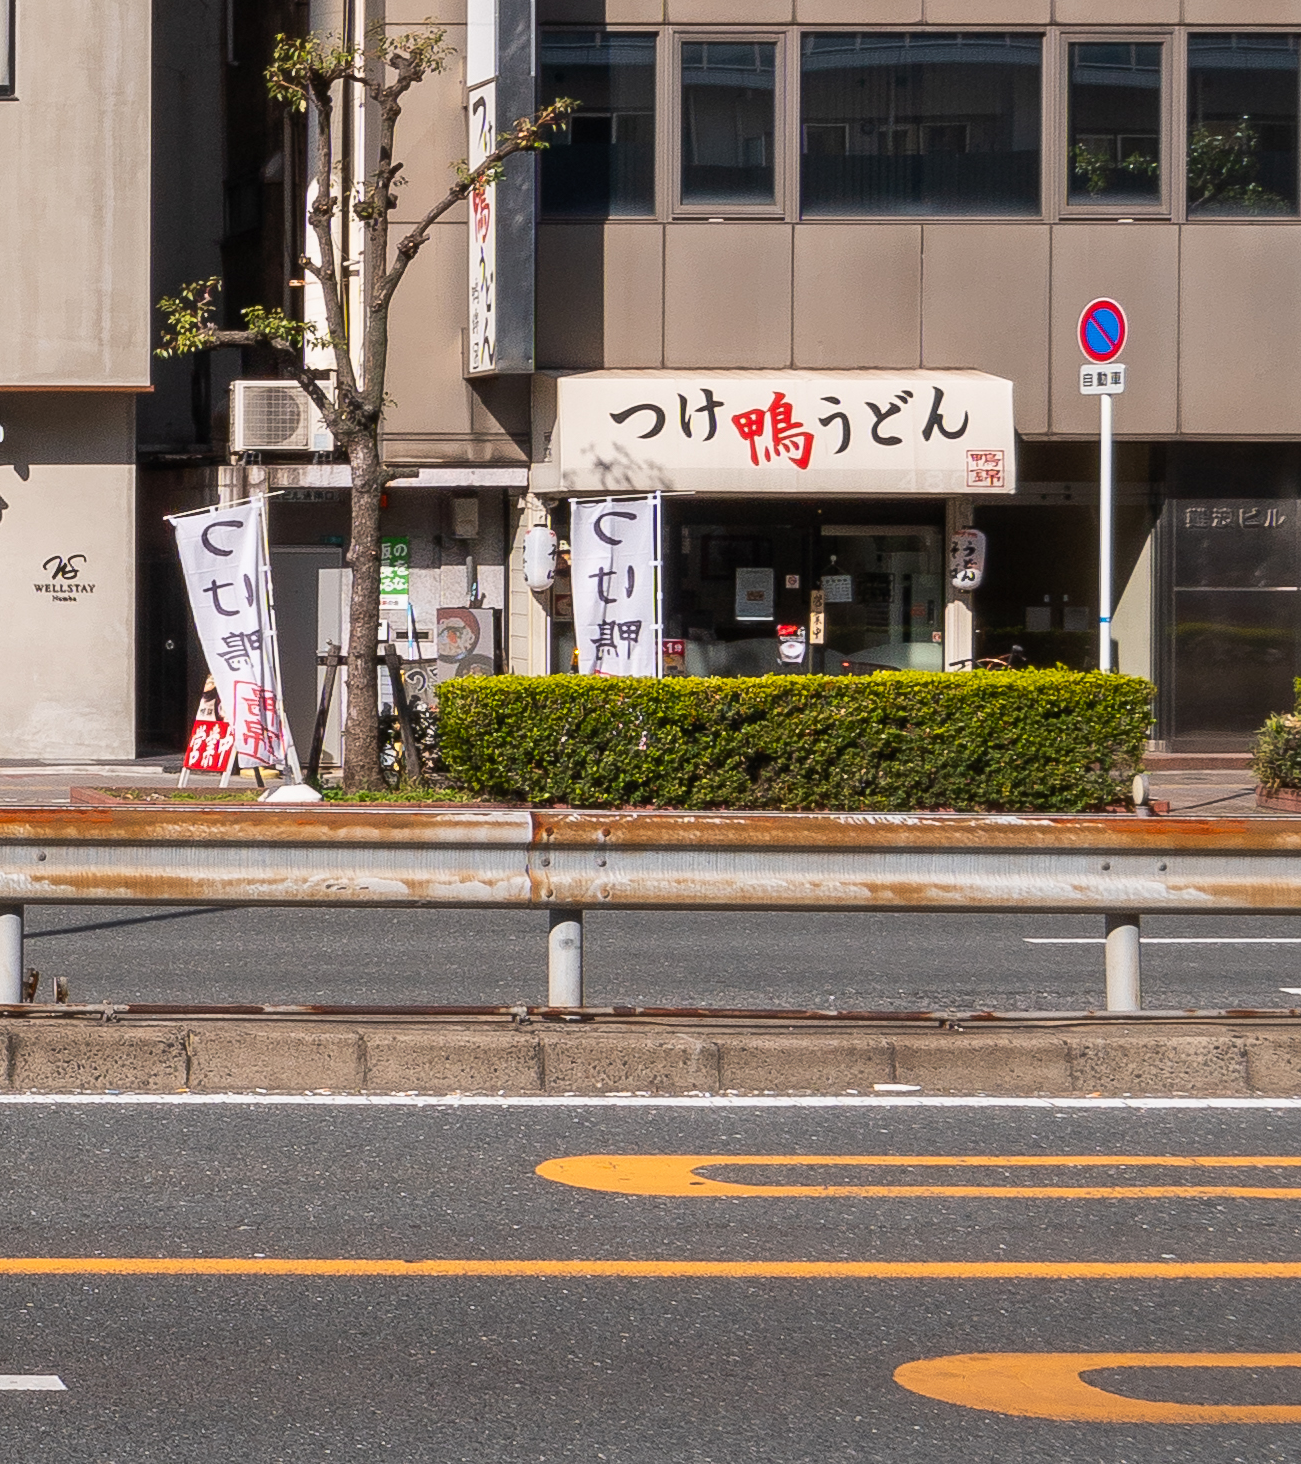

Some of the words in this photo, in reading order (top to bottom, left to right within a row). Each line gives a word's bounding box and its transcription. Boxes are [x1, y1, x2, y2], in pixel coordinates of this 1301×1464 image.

[1082, 371, 1122, 387] 自動車
[609, 386, 969, 470] つけ鴨うどん
[1184, 507, 1286, 528] 難波ビル
[33, 583, 96, 594] WELLSTAY
[188, 723, 235, 769] 営業中
